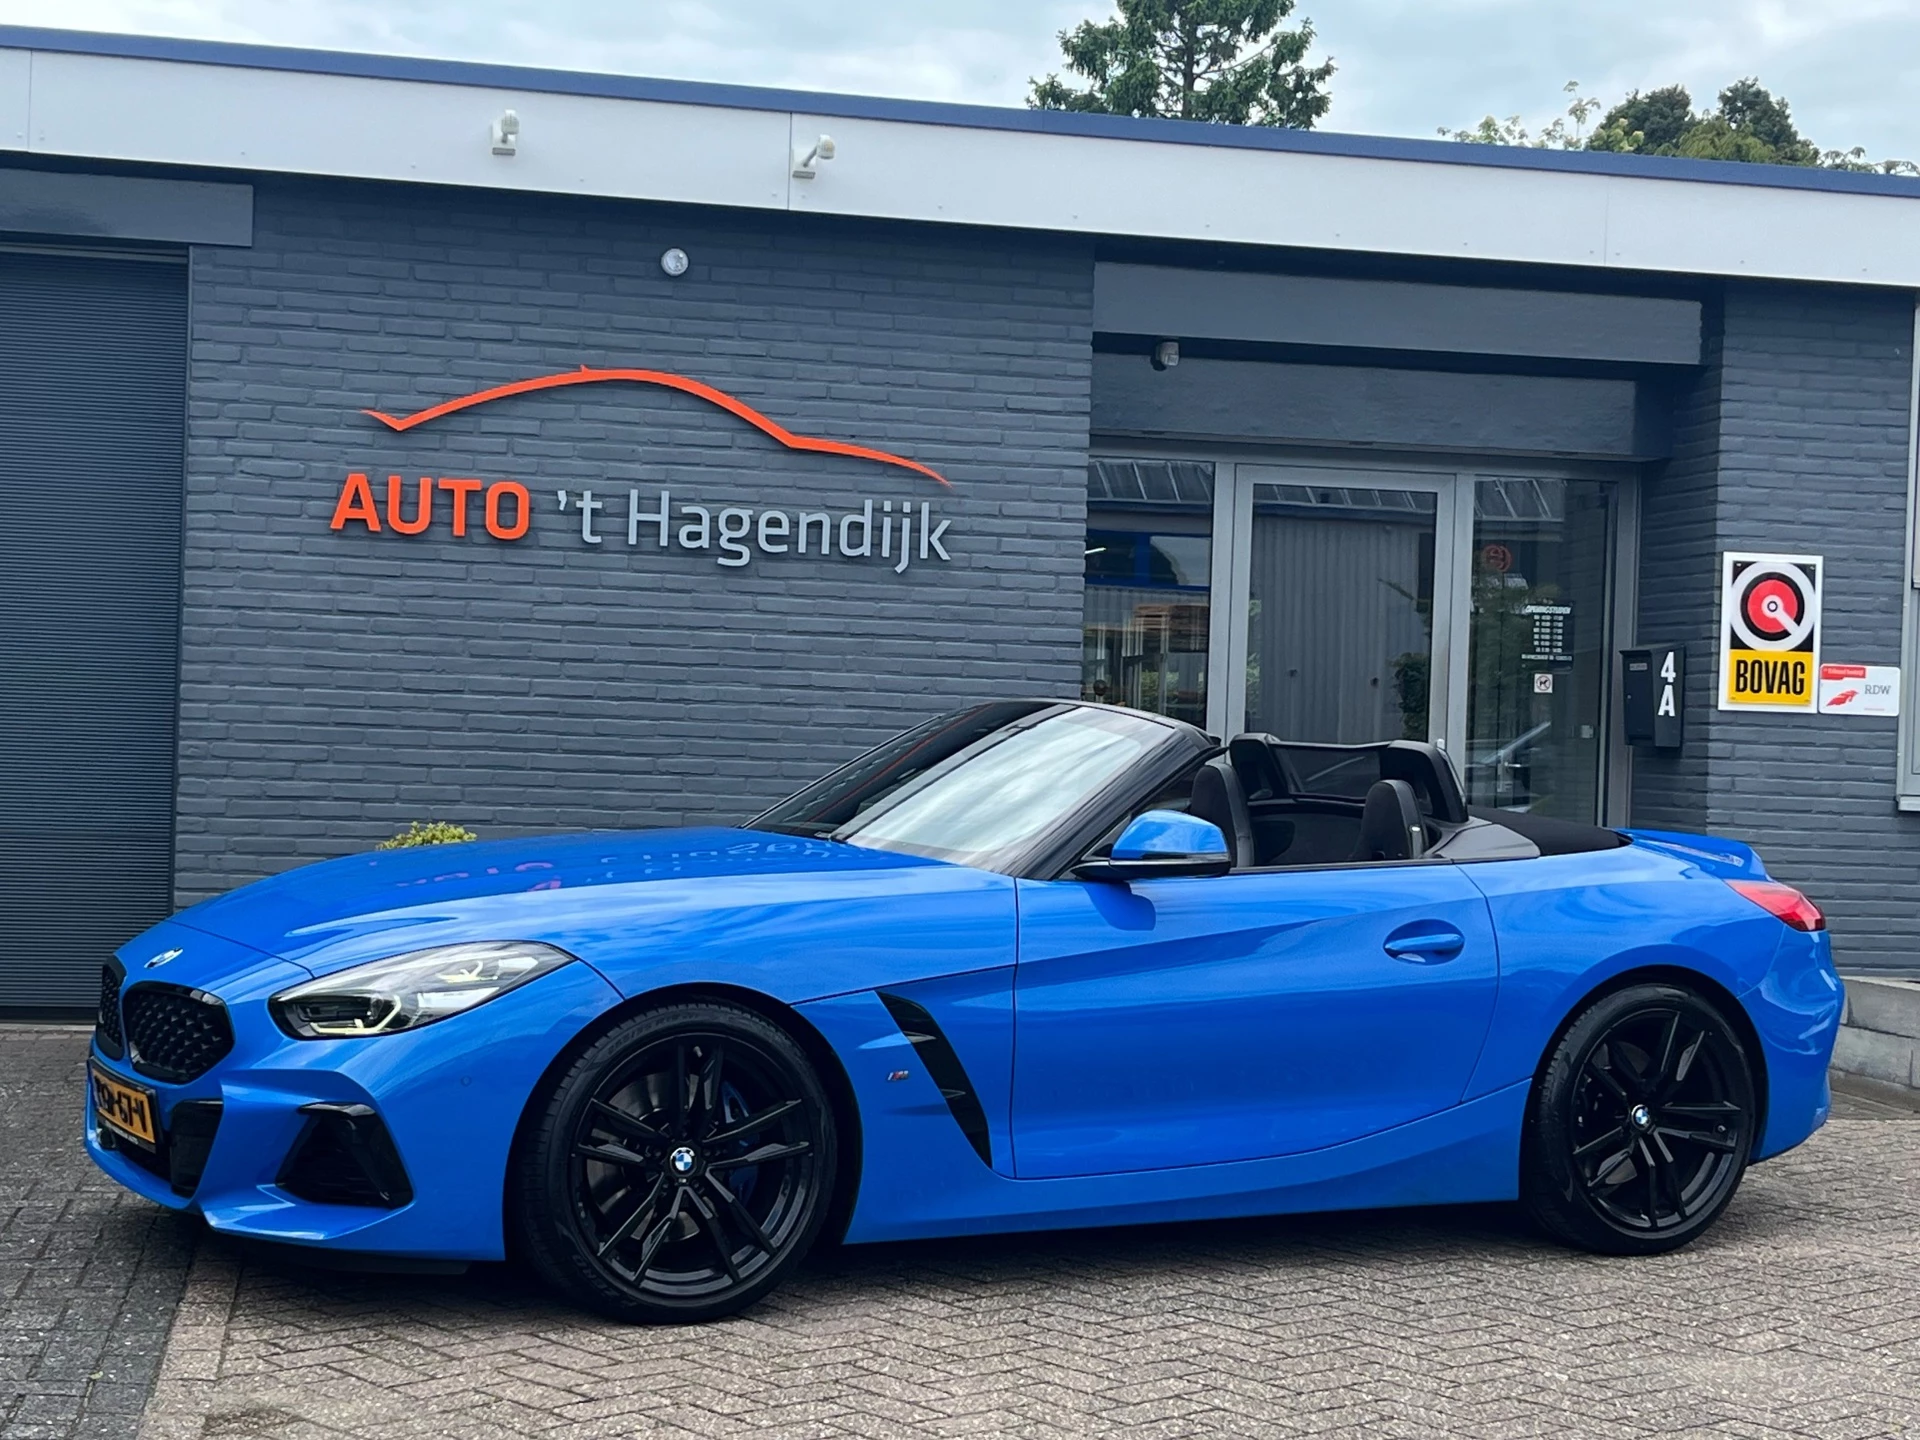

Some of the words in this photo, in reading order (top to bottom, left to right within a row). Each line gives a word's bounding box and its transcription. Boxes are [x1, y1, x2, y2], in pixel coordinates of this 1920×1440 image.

[331, 473, 529, 539] AUTO
[629, 490, 951, 573] Hagendijk
[1661, 652, 1675, 682] 4
[1736, 660, 1804, 695] BOVAG
[1658, 685, 1674, 716] A
[1865, 685, 1891, 694] RDW
